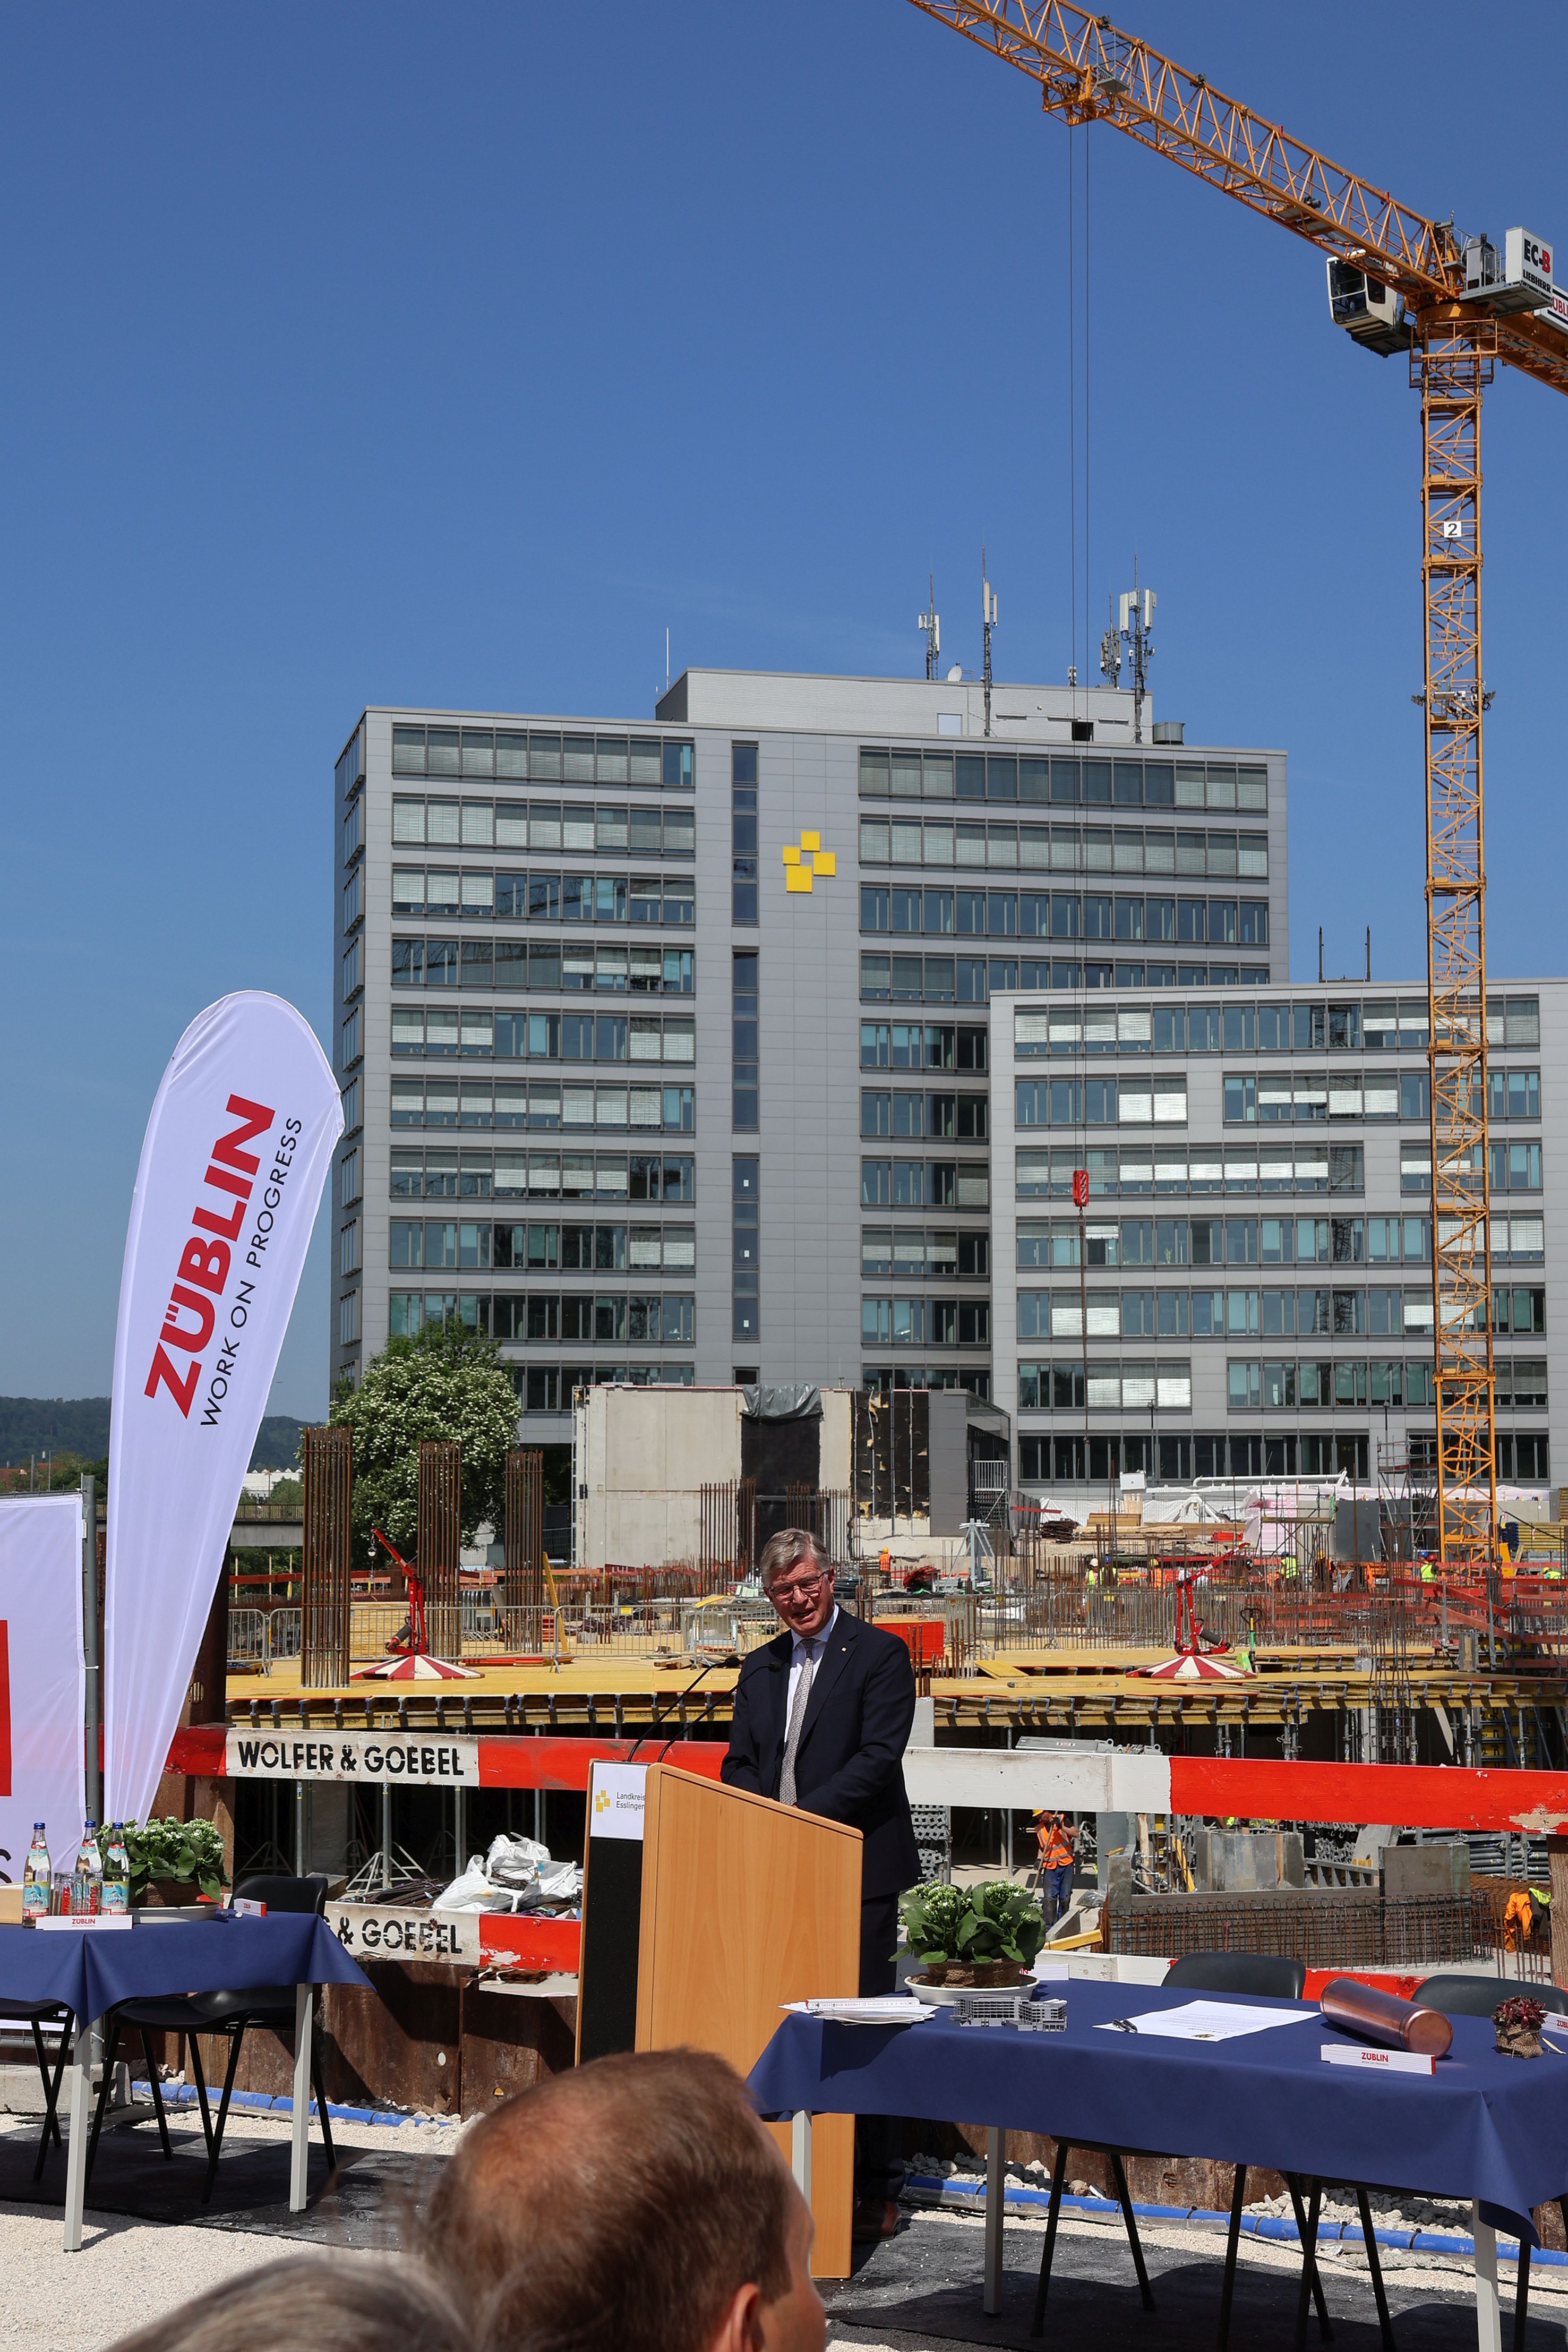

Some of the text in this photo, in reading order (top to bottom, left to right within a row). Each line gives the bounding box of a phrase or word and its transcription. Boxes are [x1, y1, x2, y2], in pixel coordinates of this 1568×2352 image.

[1524, 238, 1550, 273] EC-B
[1523, 269, 1551, 294] LIEBHERR
[1447, 523, 1458, 536] 2
[144, 1093, 275, 1418] ZÜBLIN
[201, 1118, 302, 1425] WORK ON PROGRESS
[237, 1741, 465, 1776] WOLFER & GOEBEL
[616, 1792, 646, 1801] Landkreis
[338, 1916, 463, 1954] & GOEBEL
[1361, 2052, 1389, 2063] ZÜBLIN
